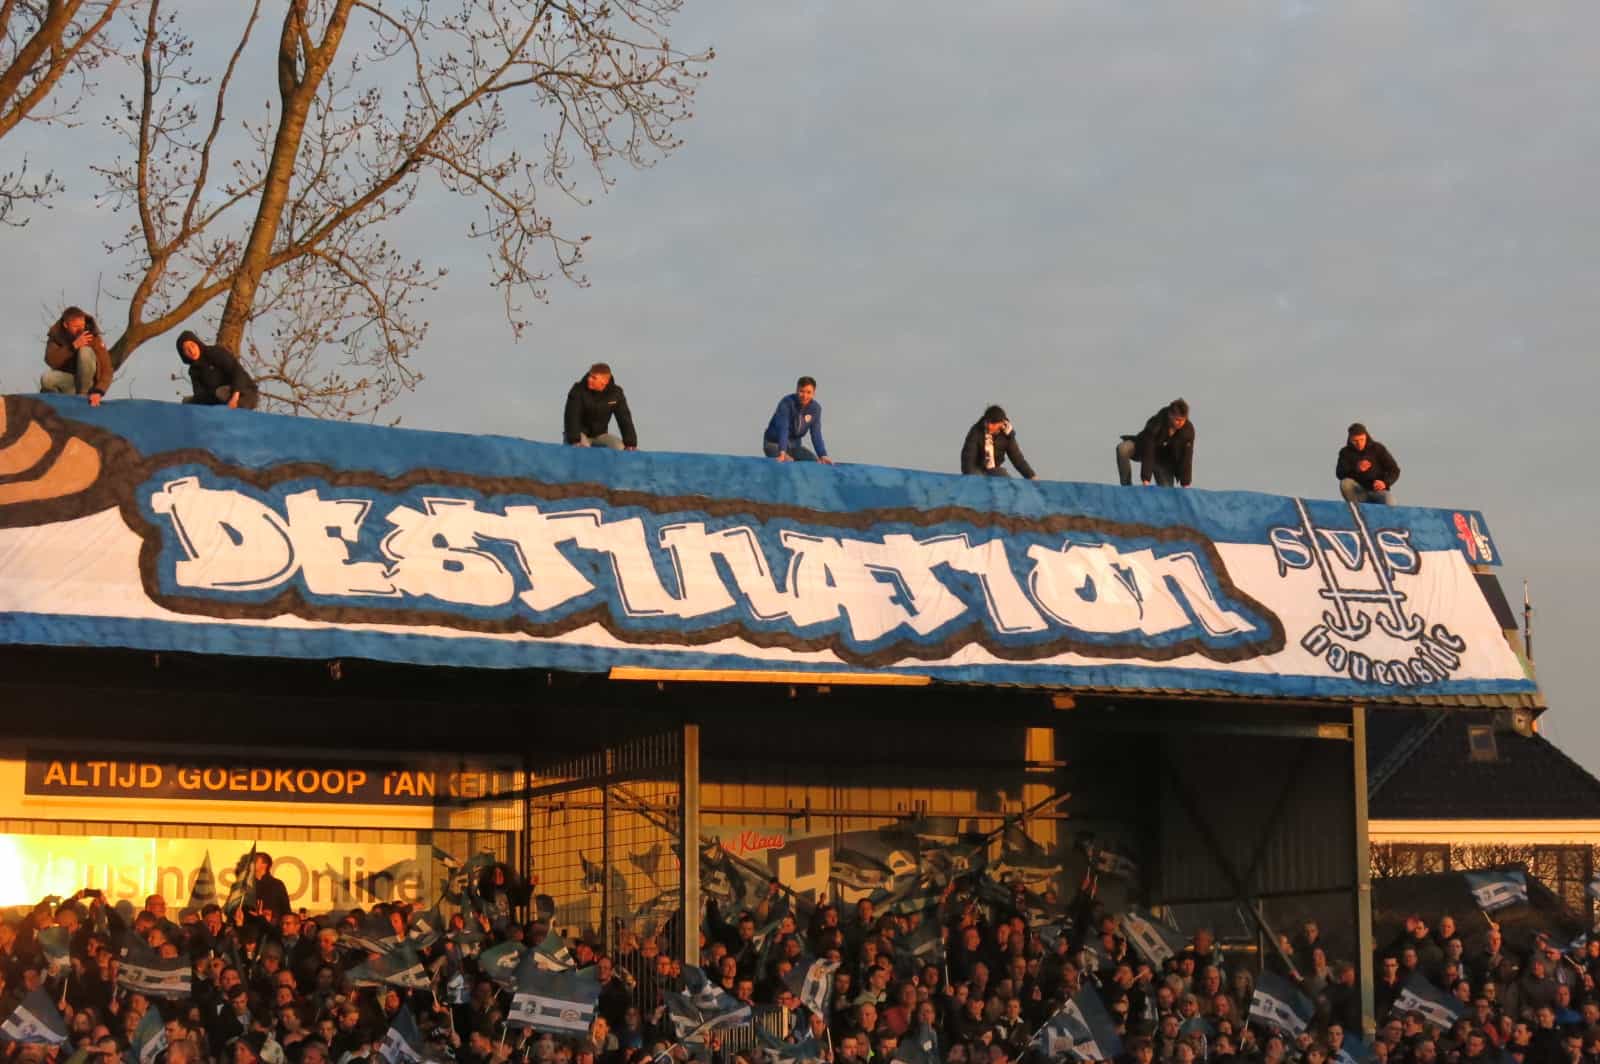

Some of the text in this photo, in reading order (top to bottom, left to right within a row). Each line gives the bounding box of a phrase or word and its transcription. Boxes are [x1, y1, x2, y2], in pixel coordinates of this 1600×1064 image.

[1268, 525, 1422, 579] SVS
[43, 760, 163, 788] ALTIJD
[177, 767, 368, 794] GOEDKOOP
[276, 856, 424, 904] Online
